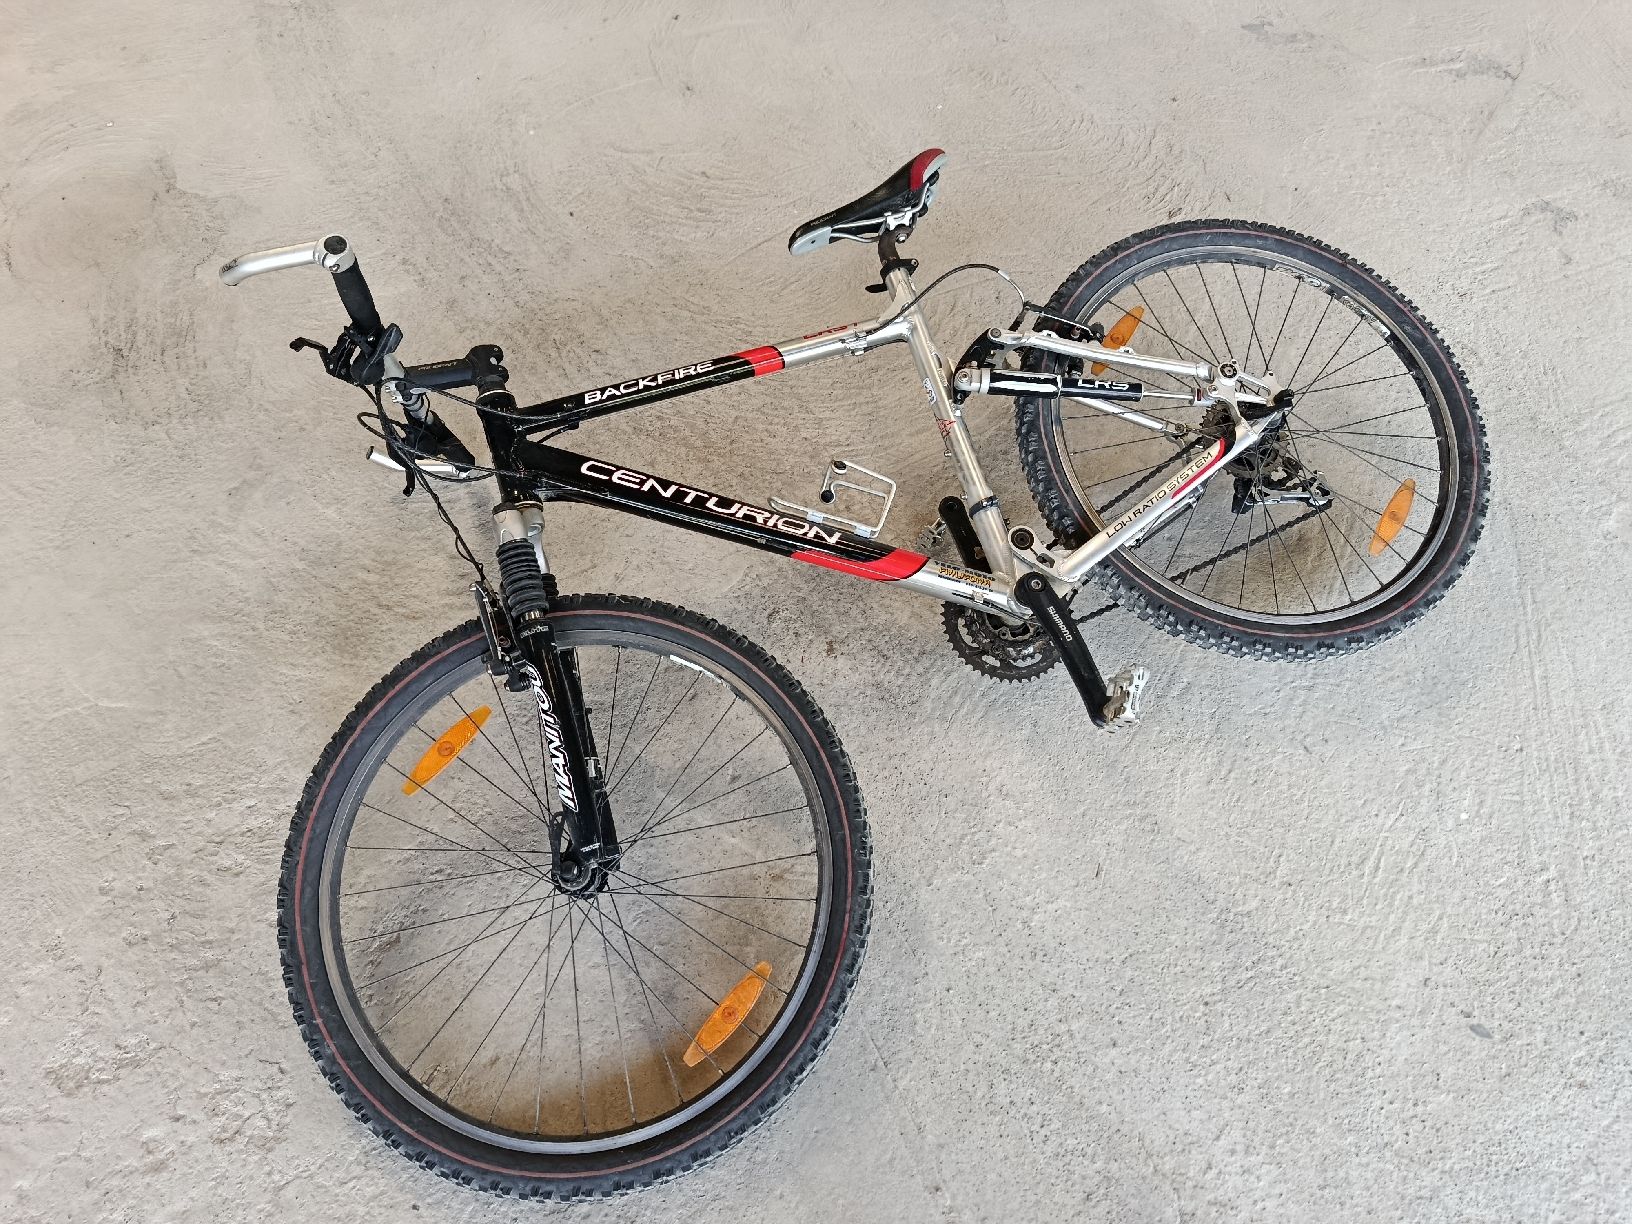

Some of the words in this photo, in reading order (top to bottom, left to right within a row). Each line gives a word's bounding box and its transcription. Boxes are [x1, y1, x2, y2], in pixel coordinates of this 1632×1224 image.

[584, 360, 715, 405] BACKFIRE
[1077, 379, 1130, 391] LRS
[580, 460, 841, 545] CENTURION
[1106, 516, 1133, 539] LOW
[1132, 489, 1167, 518] RATIO
[1166, 451, 1213, 492] SYSTEM
[1047, 605, 1073, 642] SHIMANO
[523, 660, 579, 813] MANITOU
